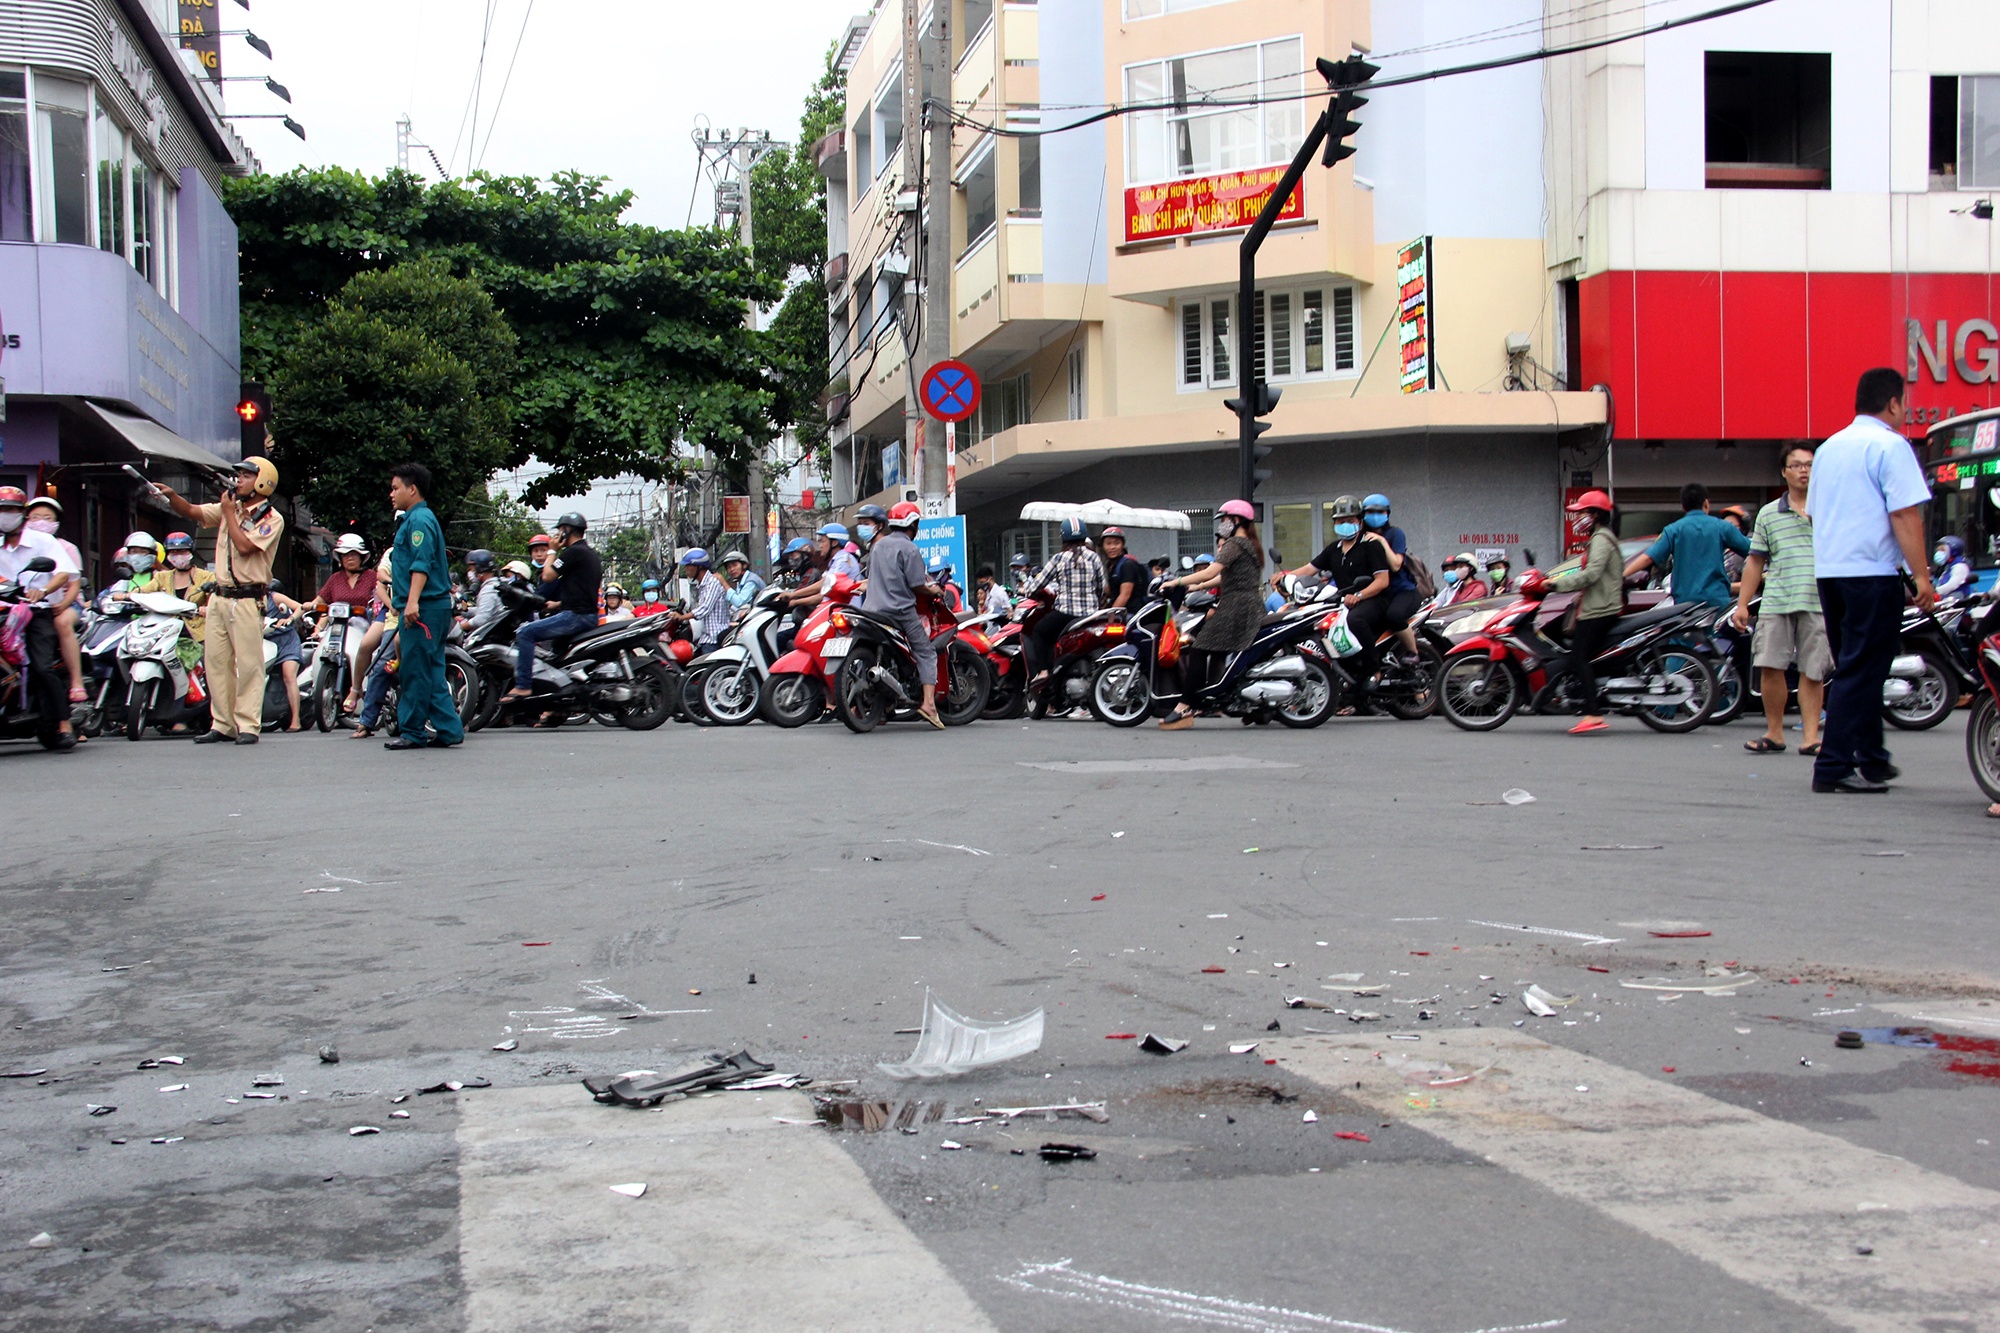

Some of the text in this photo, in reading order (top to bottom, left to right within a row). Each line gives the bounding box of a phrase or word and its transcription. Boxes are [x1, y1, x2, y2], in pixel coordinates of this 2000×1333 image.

[1140, 190, 1155, 202] BAN
[1170, 184, 1185, 198] HUY
[1241, 172, 1257, 187] PHÚ
[1132, 214, 1151, 234] BAN
[1154, 204, 1171, 231] CHỈ
[1174, 207, 1194, 228] HUY
[1197, 199, 1225, 227] QUÂN
[1226, 198, 1240, 223] SỰ
[1289, 192, 1296, 212] 3
[1975, 422, 1995, 449] 55
[931, 522, 955, 539] CHỐNG
